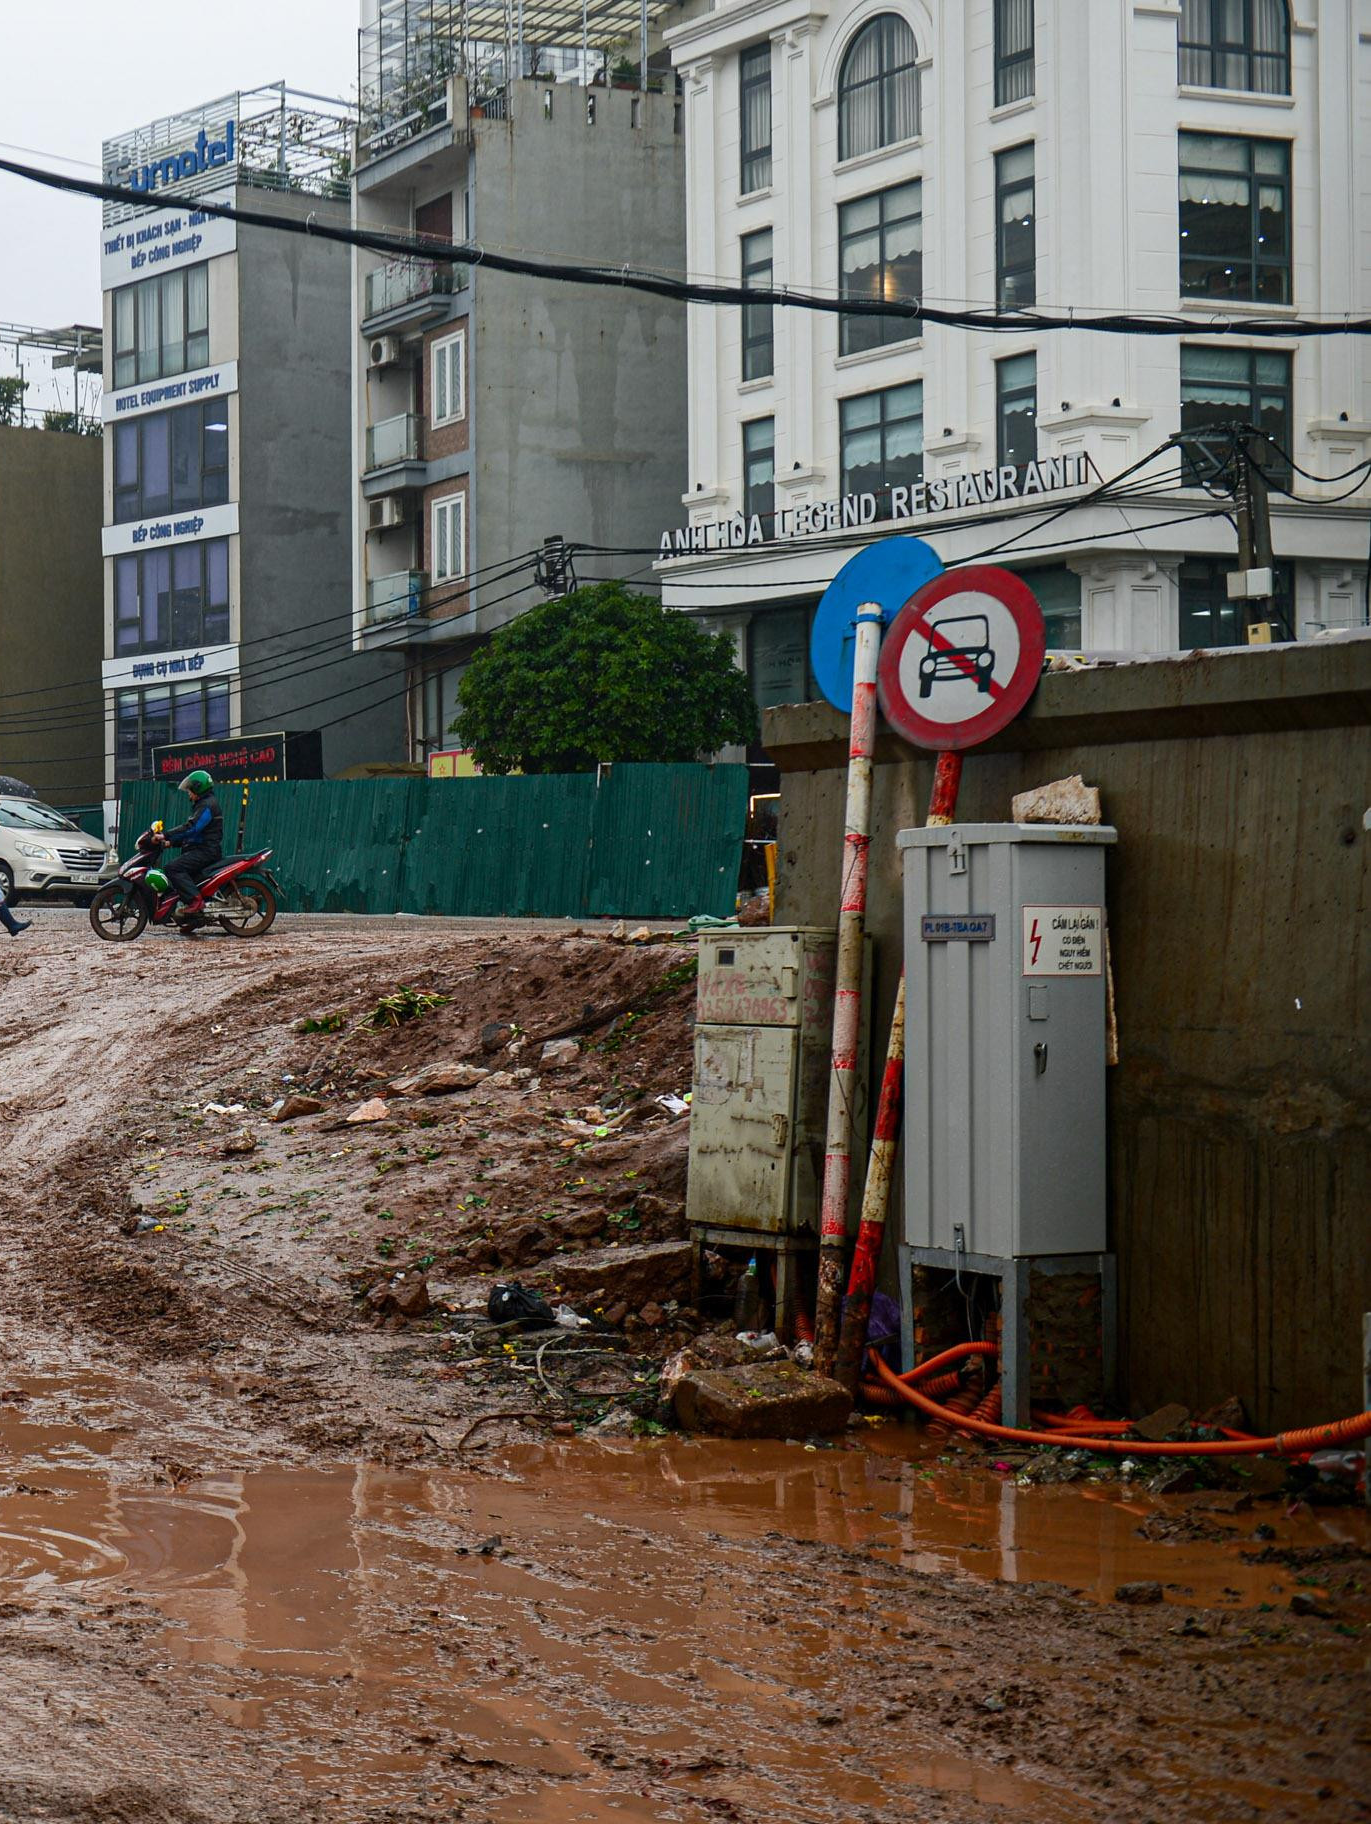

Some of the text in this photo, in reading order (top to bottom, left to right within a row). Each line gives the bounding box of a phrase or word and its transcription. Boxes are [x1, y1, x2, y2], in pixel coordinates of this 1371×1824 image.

[136, 223, 162, 244] KHÁCH
[164, 218, 181, 236] SẠN
[131, 234, 202, 269] BẾP CÔNG NGHIỆP
[116, 374, 220, 412] HOTEL EQUIPMENT SUPPLY
[659, 451, 1086, 560] ANH HÒA LEGEND RESTAURANT
[132, 516, 204, 543] BẾP CÔNG NGHIỆP
